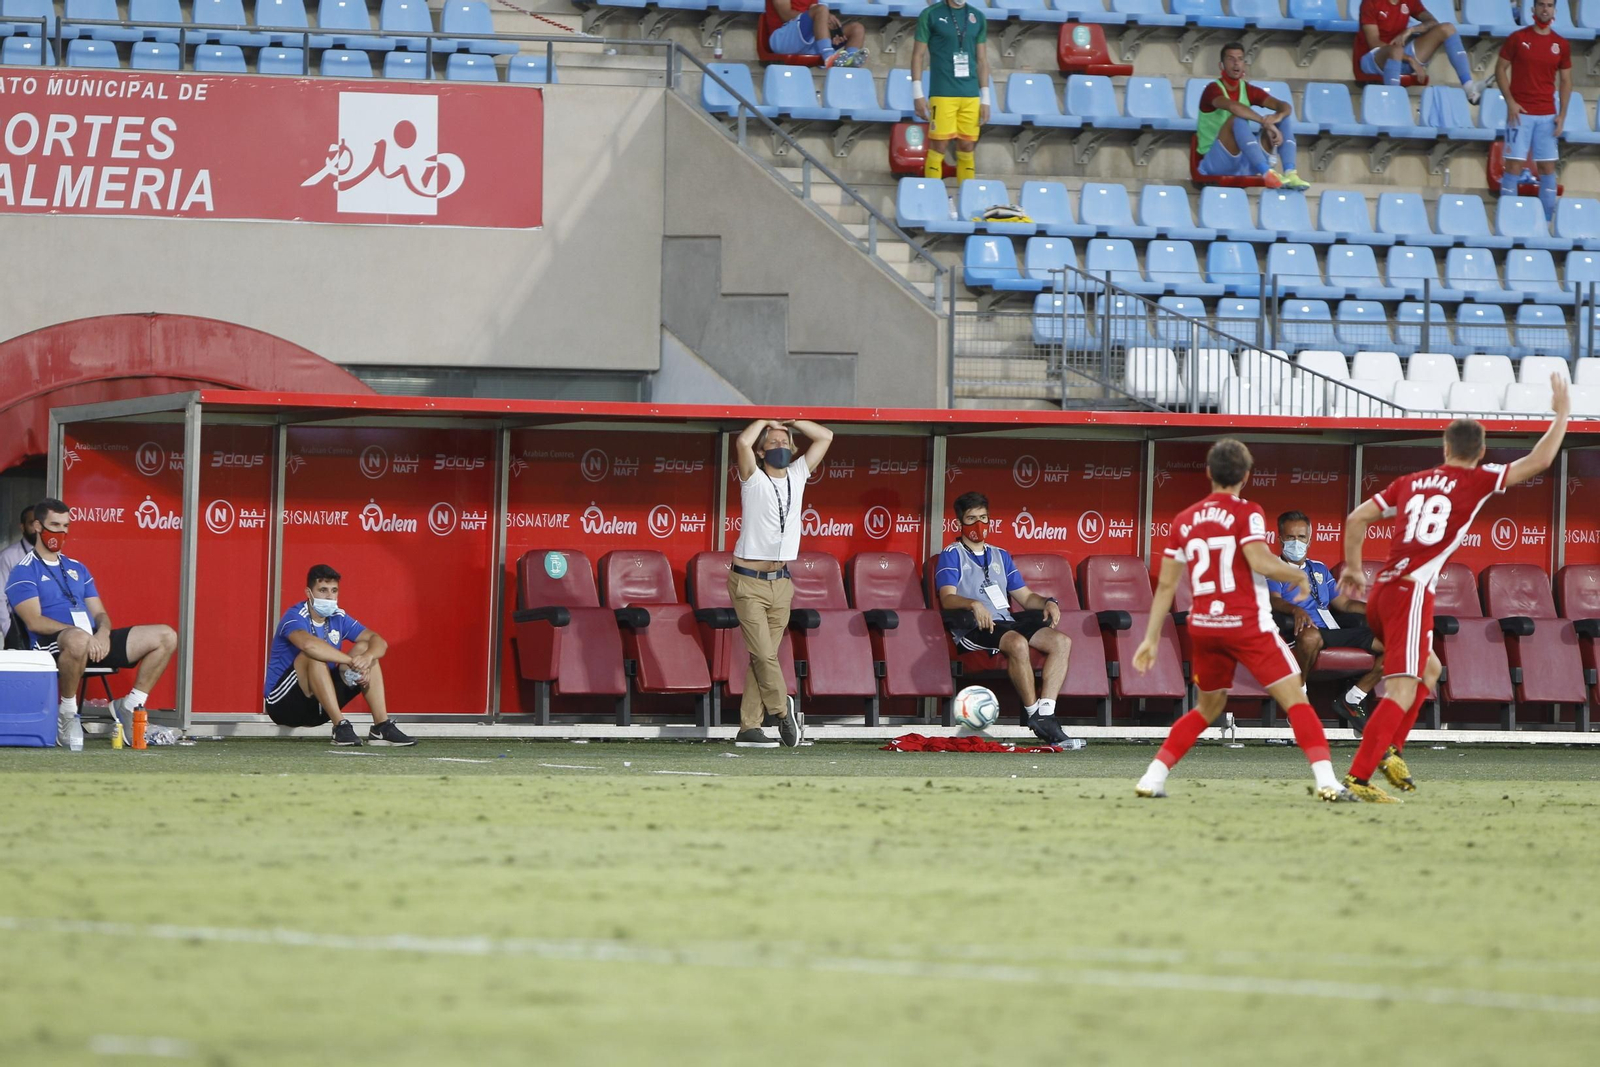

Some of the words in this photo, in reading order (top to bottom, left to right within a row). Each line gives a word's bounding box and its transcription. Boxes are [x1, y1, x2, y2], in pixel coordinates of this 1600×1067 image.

[46, 78, 169, 100] MUNICIPAL
[178, 83, 208, 100] DE
[4, 112, 178, 160] ORTES
[210, 451, 264, 467] 3days
[522, 450, 549, 458] Arabian
[958, 456, 982, 464] Arabian
[170, 461, 184, 470] NA
[392, 464, 419, 473] NAFT
[434, 454, 486, 470] 3days
[653, 457, 704, 474] 3days
[868, 458, 918, 474] 3days
[614, 467, 639, 476] NAFT
[830, 470, 854, 478] NAFT
[1044, 474, 1069, 482] NAFT
[1082, 463, 1132, 480] 3days
[1290, 468, 1339, 484] 3days
[1252, 478, 1276, 487] NAFT
[134, 498, 183, 530] Wale
[214, 508, 226, 522] N
[359, 502, 417, 532] Walem
[437, 511, 449, 524] N
[580, 504, 637, 535] Walem
[657, 514, 668, 527] N
[1192, 507, 1235, 530] ALBIAR
[1402, 494, 1452, 546] 18
[239, 519, 265, 528] NAFT
[460, 521, 487, 530] NAFT
[801, 508, 853, 537] Walem
[873, 514, 884, 528] N
[1012, 511, 1067, 540] Walem
[1086, 519, 1097, 532] N
[680, 524, 705, 532] NAFT
[896, 524, 920, 533] NAFT
[1109, 529, 1133, 538] NAFT
[1500, 526, 1510, 539] N
[1316, 533, 1340, 542] NAFT
[1522, 536, 1546, 544] NAFT
[1185, 535, 1236, 596] 27
